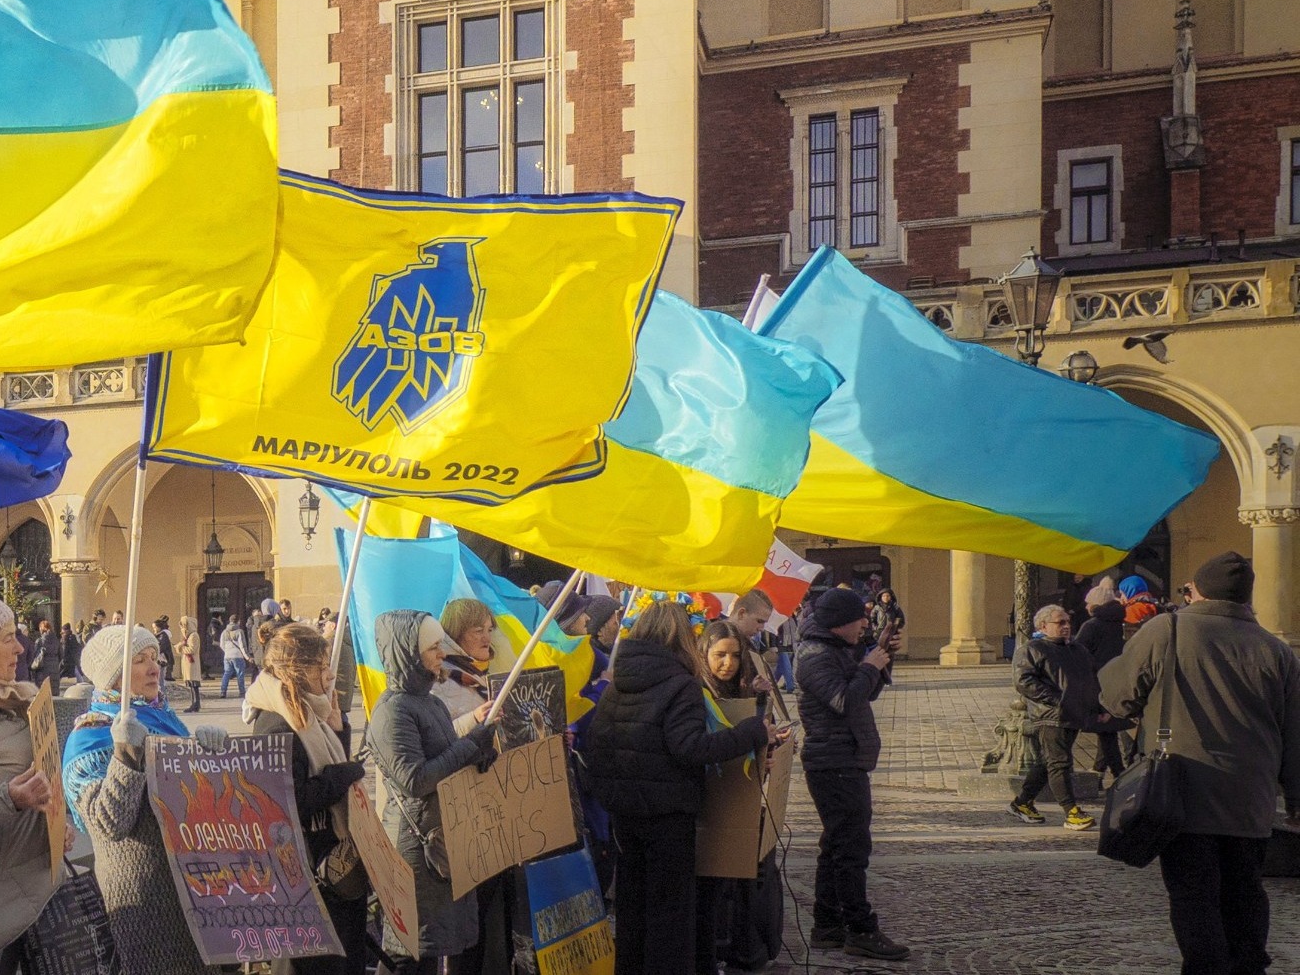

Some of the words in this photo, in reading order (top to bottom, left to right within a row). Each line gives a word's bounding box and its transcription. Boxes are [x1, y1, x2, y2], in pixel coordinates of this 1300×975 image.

[357, 324, 485, 357] АЗОВ
[252, 435, 431, 481] МАРІУПОЛЬ
[442, 462, 520, 486] 2022
[162, 757, 182, 774] НЕ
[492, 736, 564, 799] VOICE
[466, 809, 547, 883] CAPTIVES
